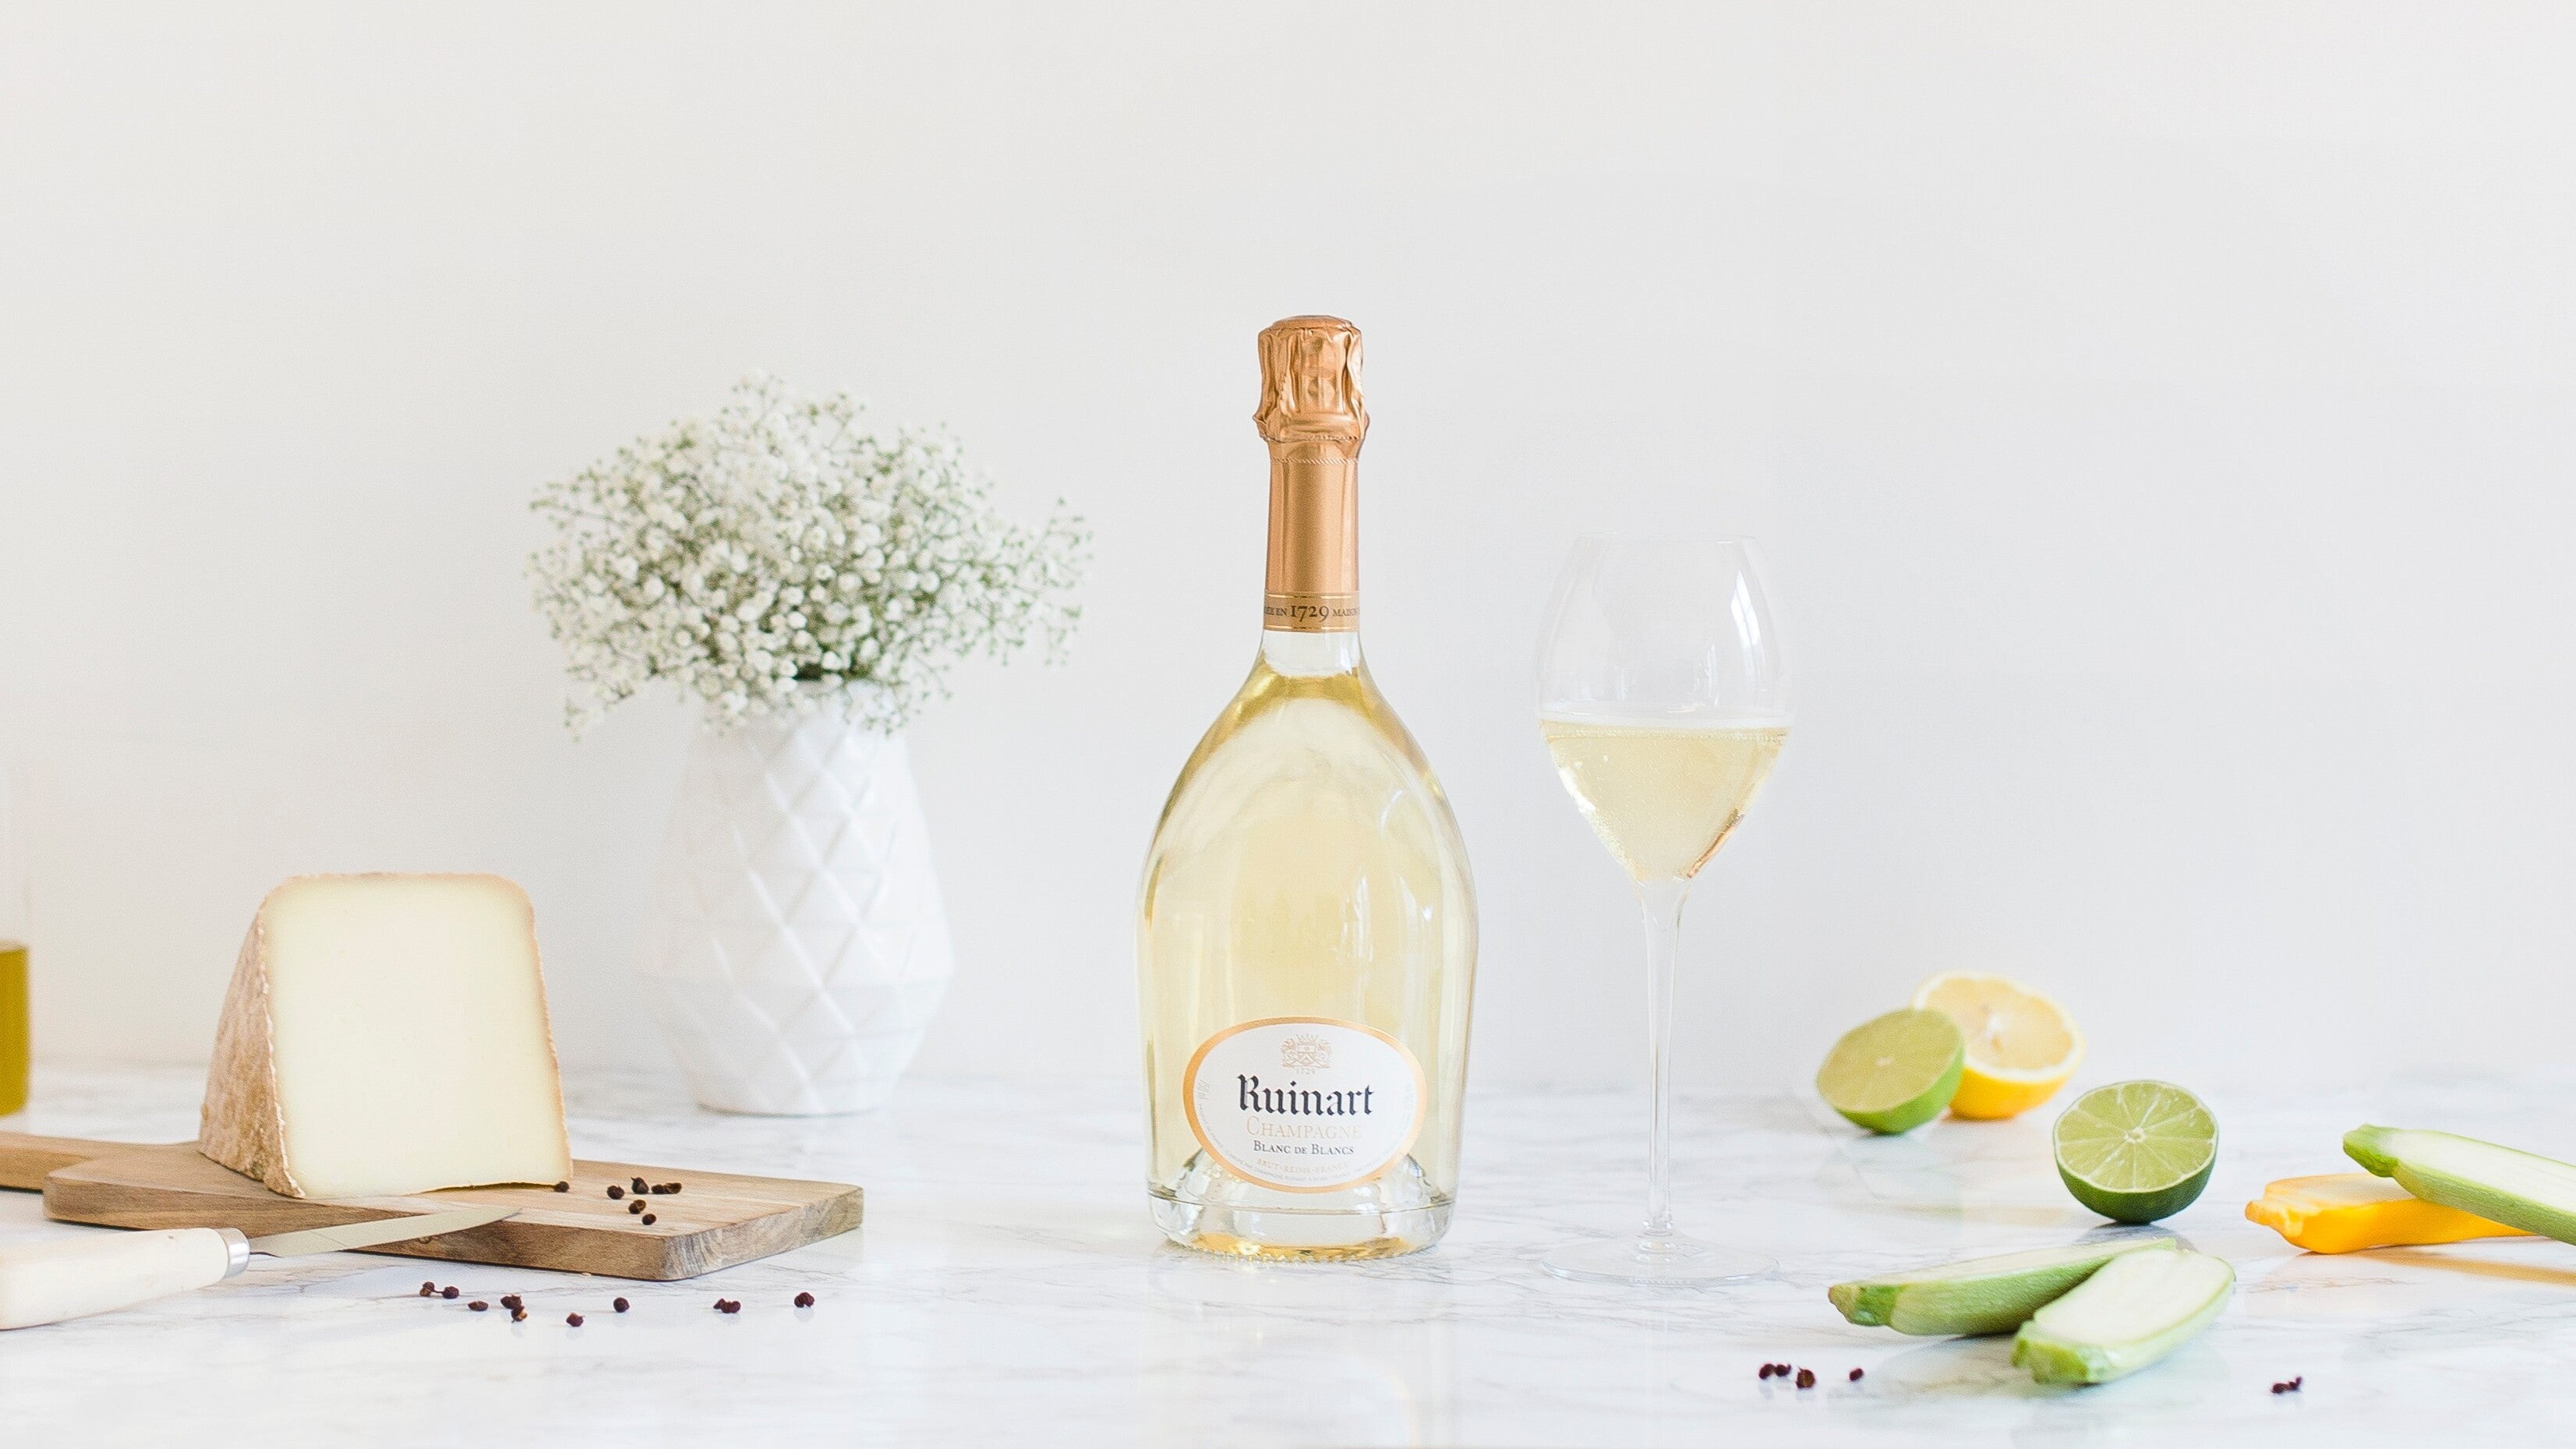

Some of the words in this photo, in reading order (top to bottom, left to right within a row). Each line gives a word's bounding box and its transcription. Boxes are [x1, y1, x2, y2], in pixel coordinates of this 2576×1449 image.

[1290, 605, 1330, 623] 1729
[1237, 1073, 1374, 1116] Ruinart
[1246, 1116, 1362, 1139] CHAMPAGNE
[1253, 1140, 1291, 1154] BLANC
[1294, 1146, 1307, 1154] DE
[1311, 1143, 1354, 1155] BLANCS
